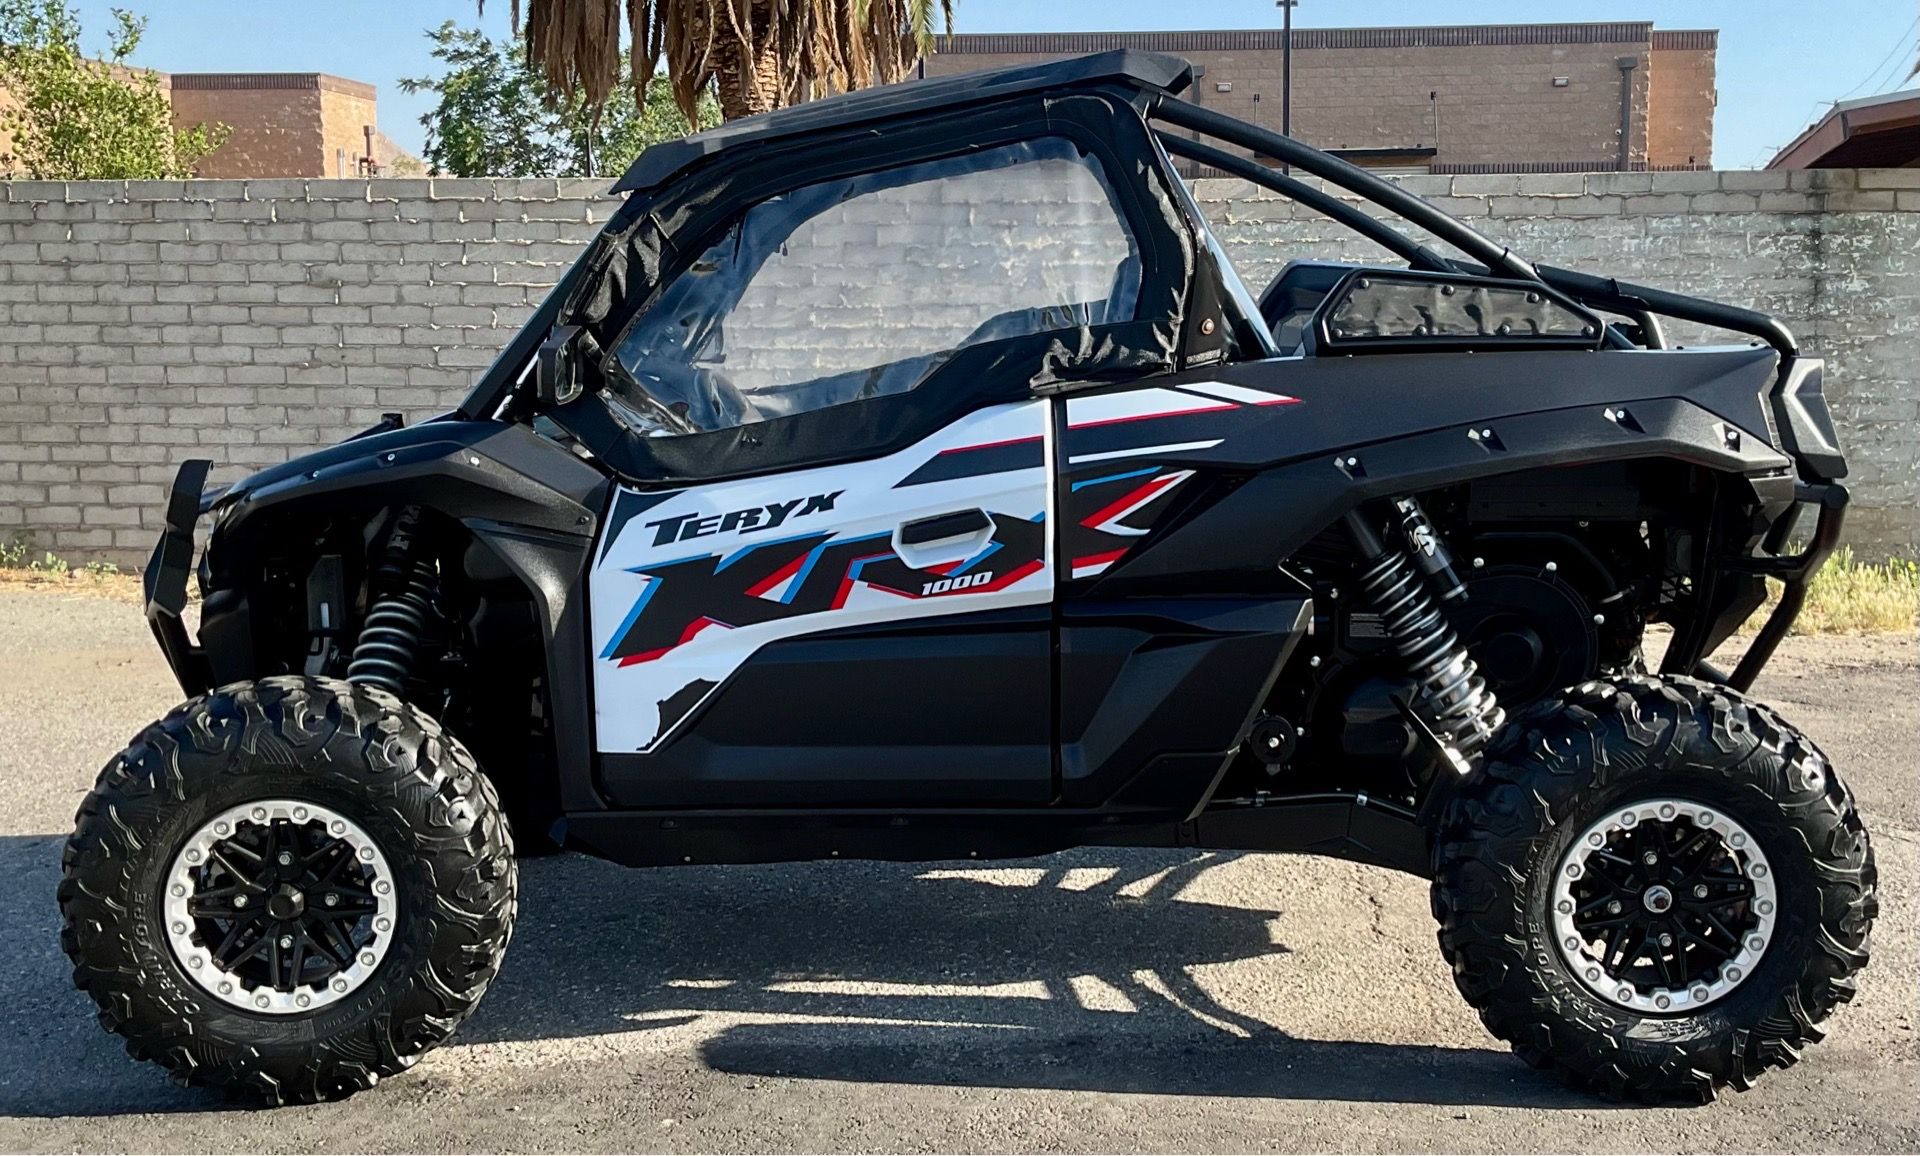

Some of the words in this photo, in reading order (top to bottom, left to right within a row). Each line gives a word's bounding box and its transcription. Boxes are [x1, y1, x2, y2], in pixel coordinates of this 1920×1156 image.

[645, 489, 846, 547] TERYX
[921, 570, 994, 597] 1000
[1528, 922, 1616, 1029] CARNIVORE
